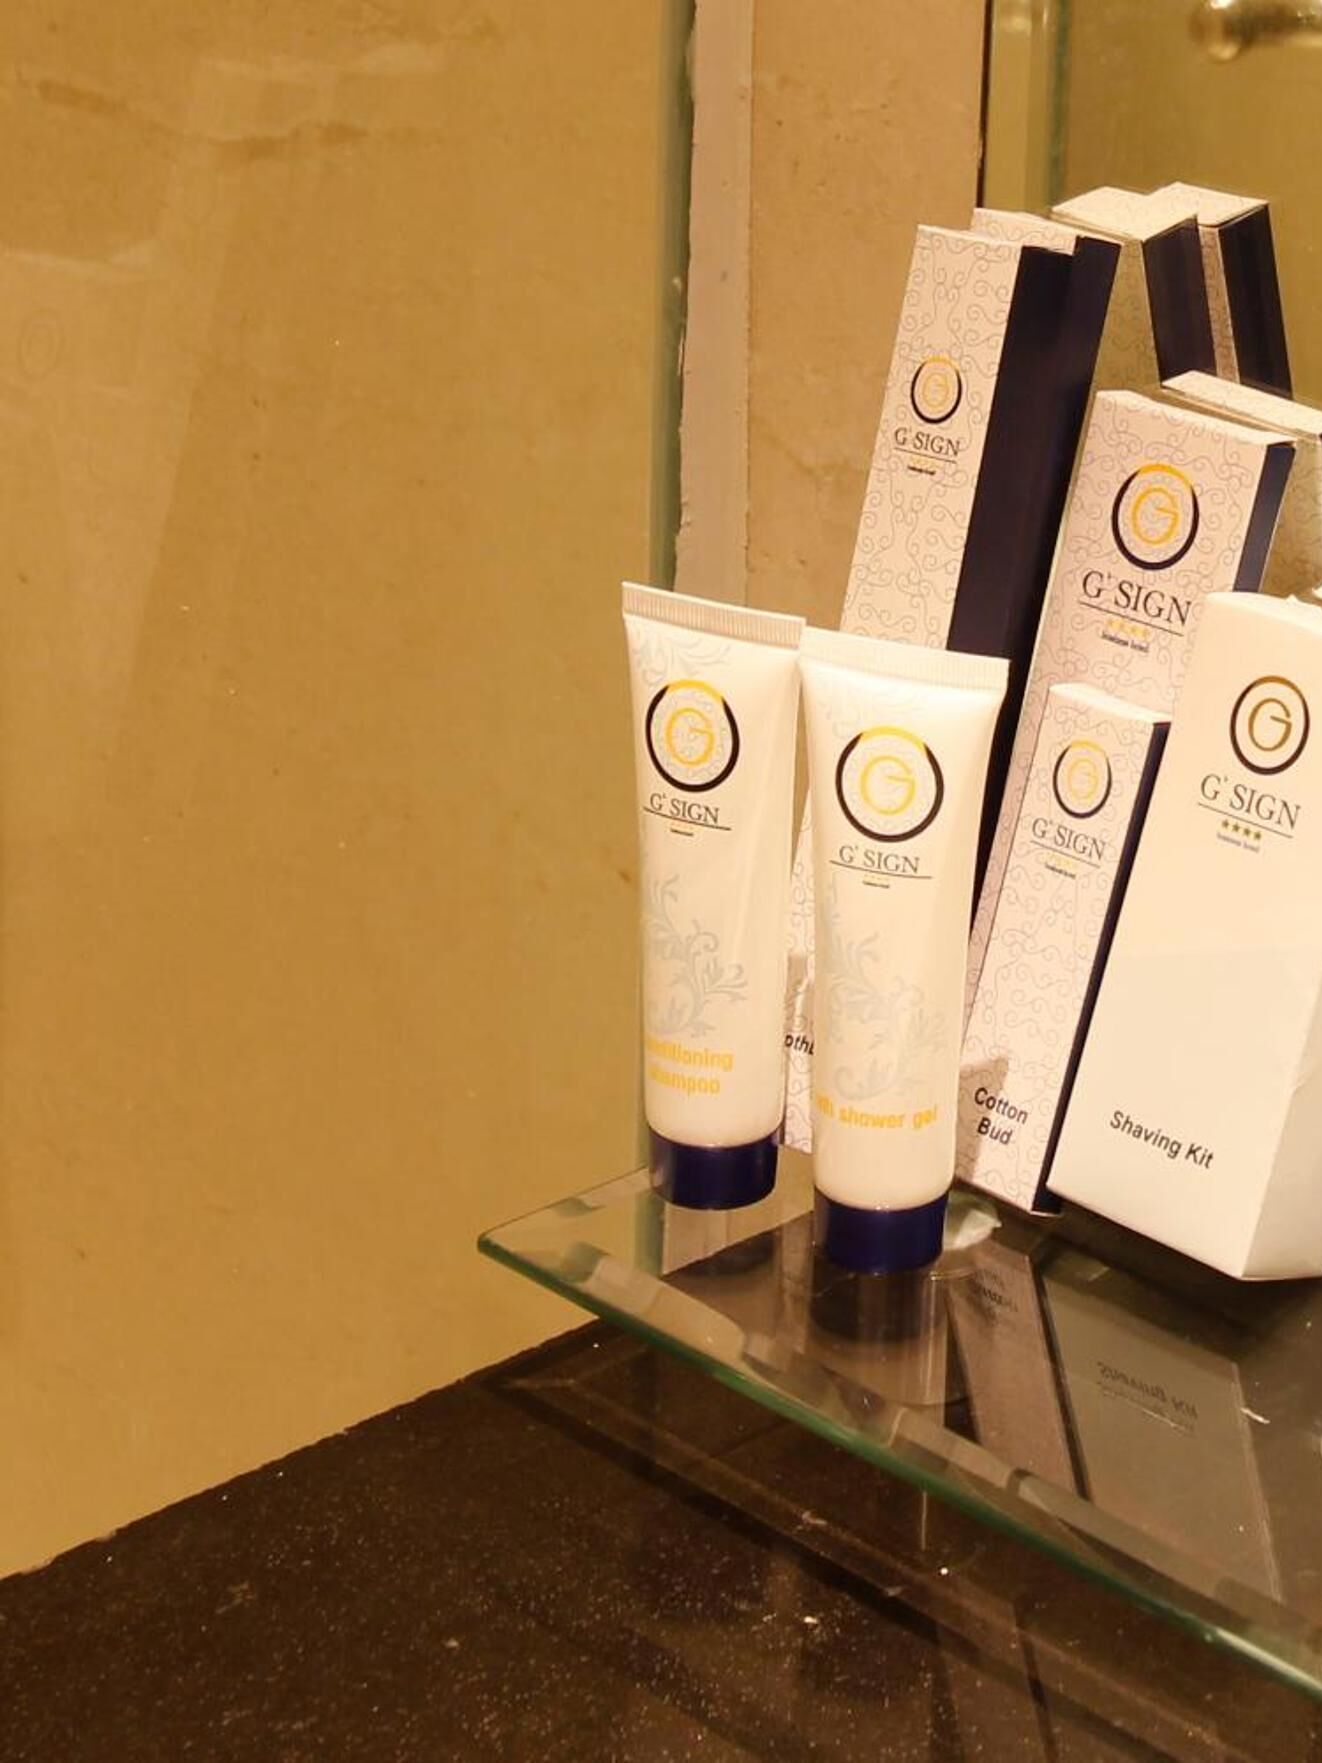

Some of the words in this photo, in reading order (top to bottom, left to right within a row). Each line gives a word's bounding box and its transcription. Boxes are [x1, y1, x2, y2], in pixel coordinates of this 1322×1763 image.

[973, 1086, 1029, 1125] Cotton
[977, 1116, 1013, 1146] Bud
[1109, 1109, 1182, 1160] Shaving
[1187, 1142, 1215, 1170] Kit
